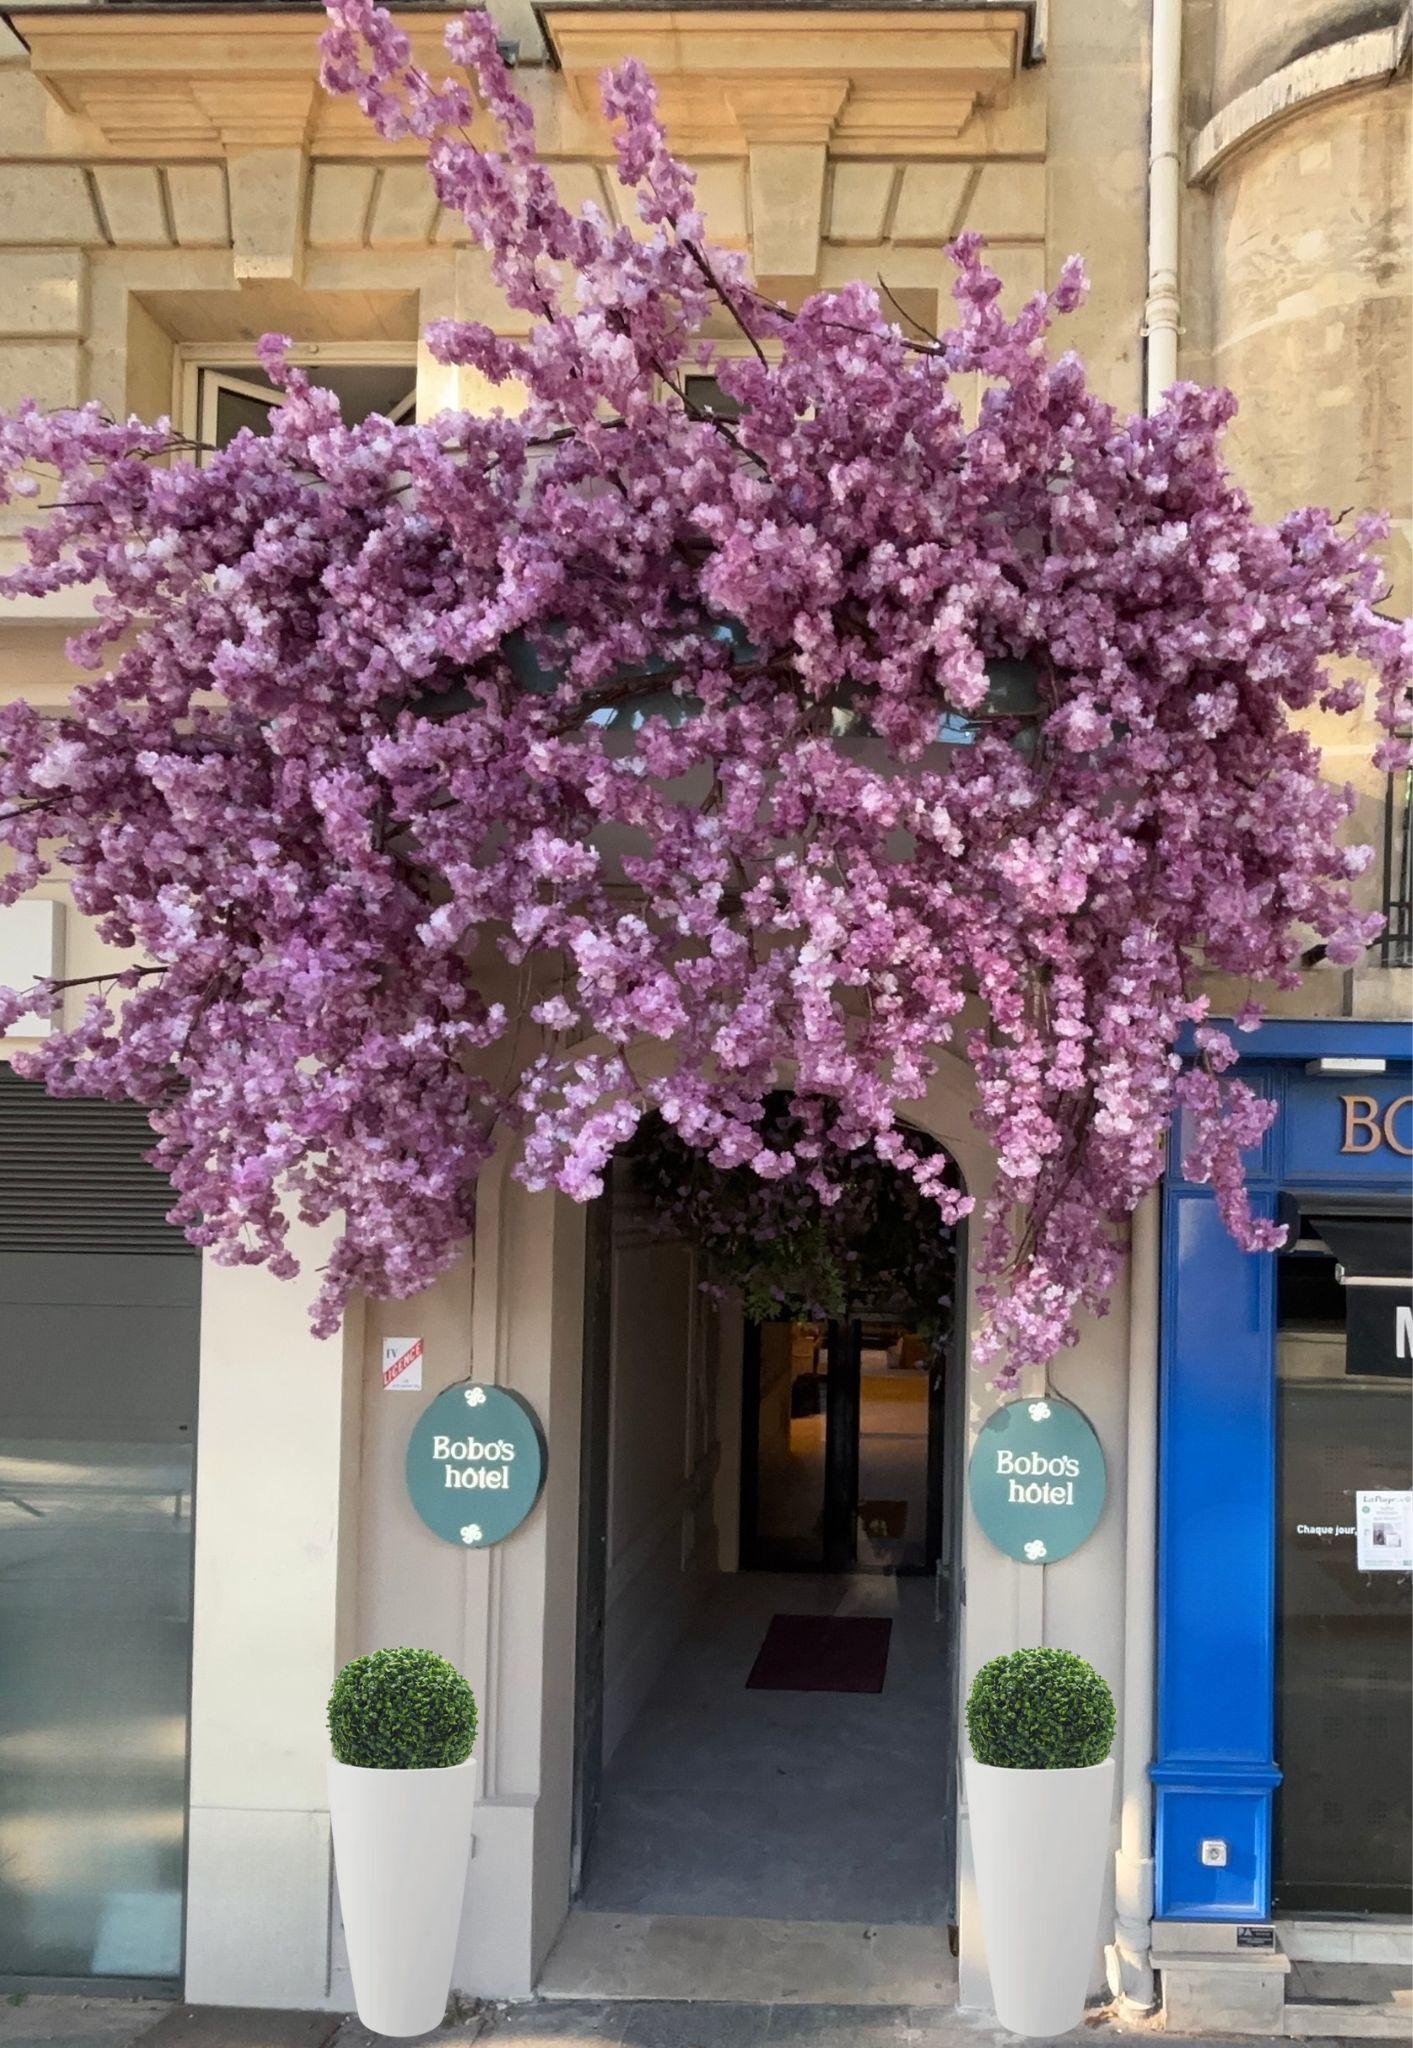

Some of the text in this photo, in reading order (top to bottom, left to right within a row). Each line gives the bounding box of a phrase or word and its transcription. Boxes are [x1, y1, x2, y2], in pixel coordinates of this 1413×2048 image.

[383, 1342, 423, 1385] LICENCE
[432, 1435, 515, 1462] Bobo's
[444, 1464, 510, 1489] hôtel
[996, 1450, 1080, 1477] Bobo's
[1008, 1479, 1074, 1505] hôtel
[1296, 1524, 1334, 1536] Chaque
